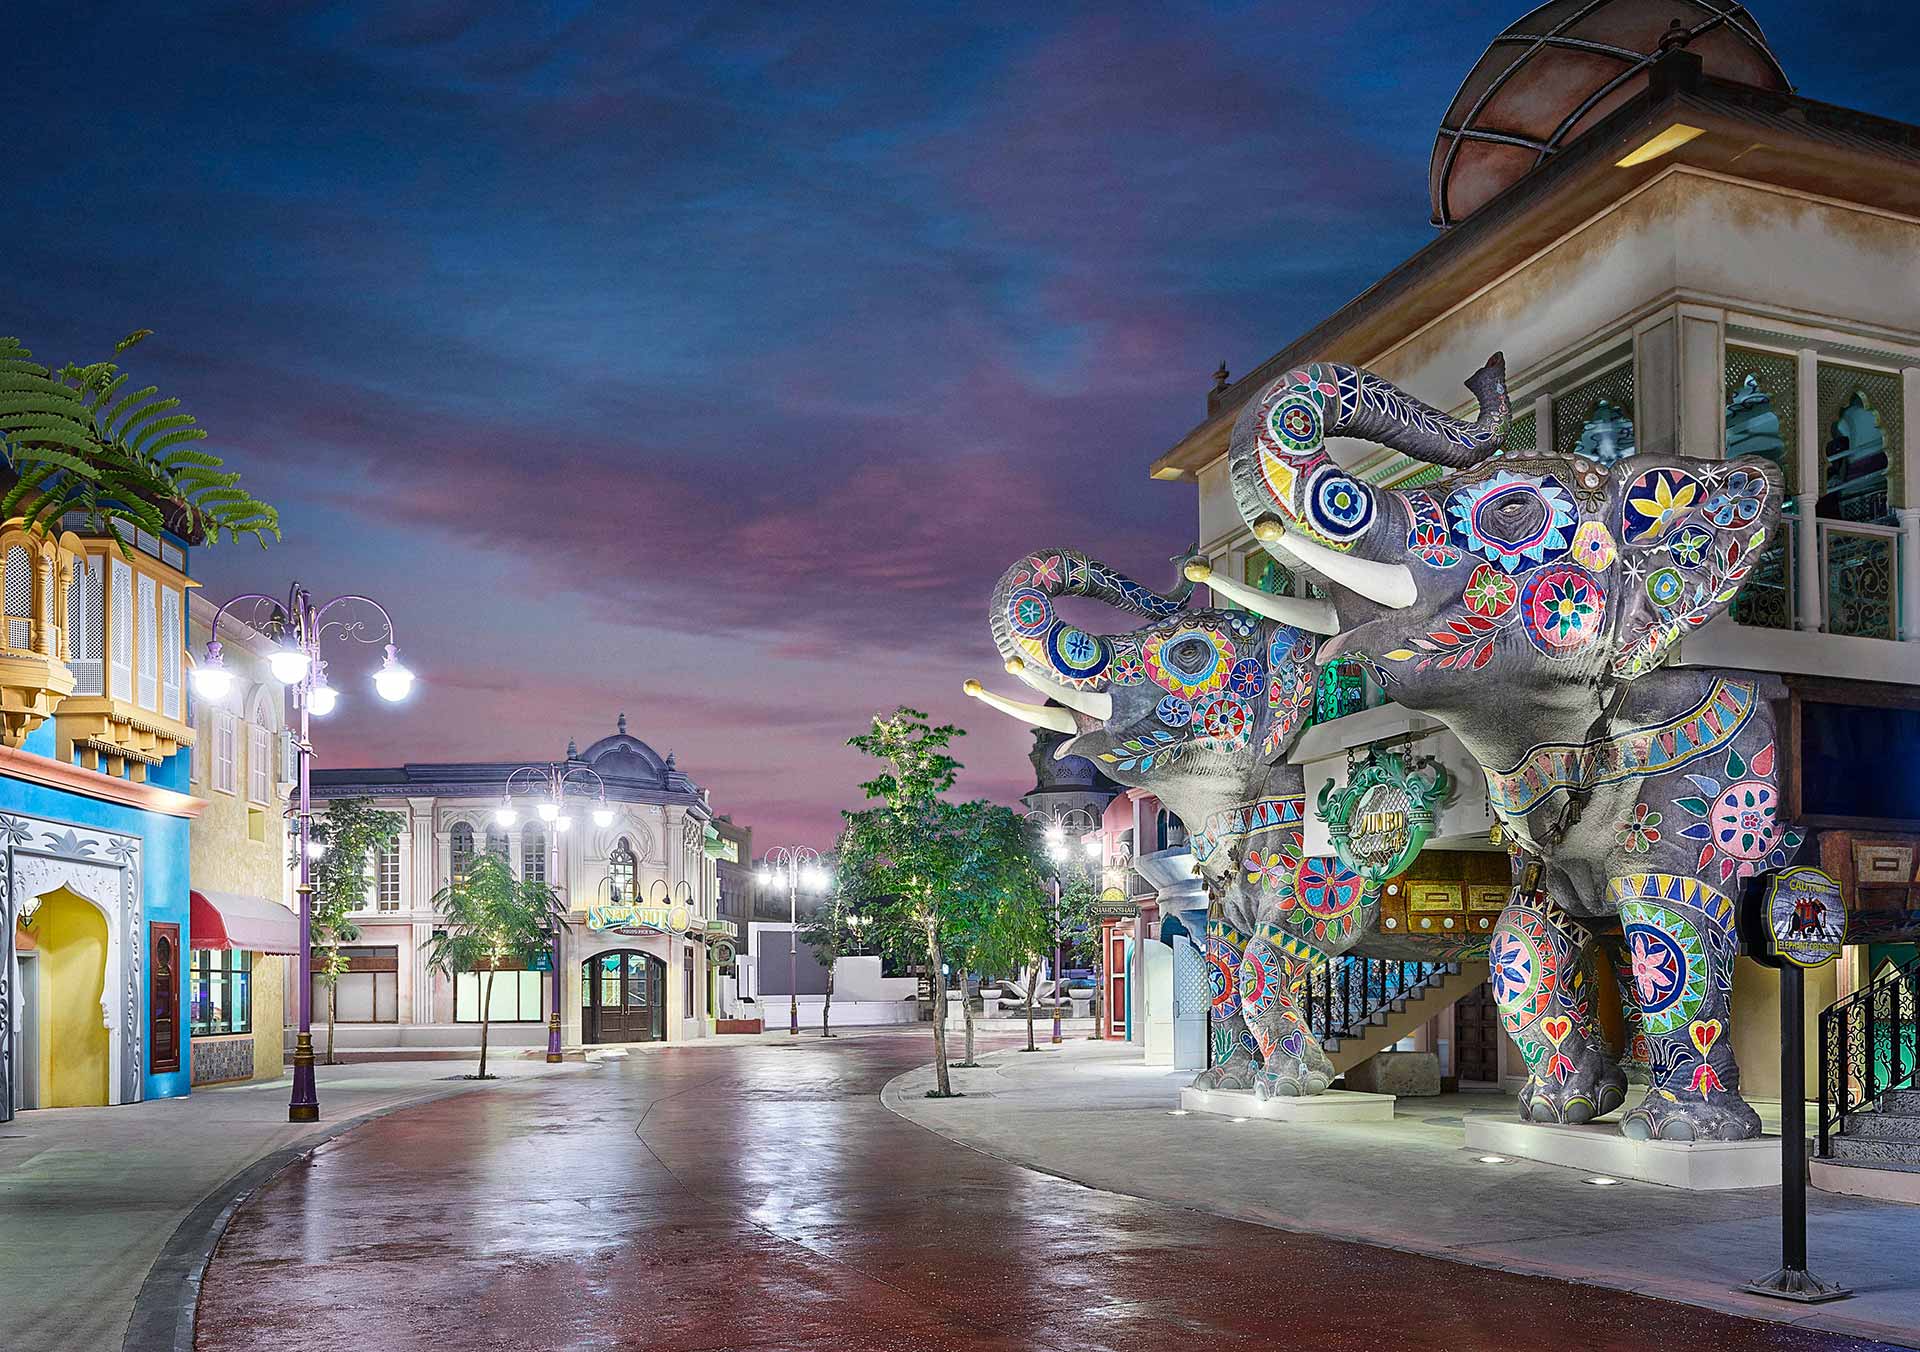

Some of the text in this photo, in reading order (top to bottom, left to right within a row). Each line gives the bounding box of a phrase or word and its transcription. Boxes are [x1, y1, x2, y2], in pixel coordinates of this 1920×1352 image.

[1349, 810, 1405, 840] JUMBO
[1789, 879, 1830, 893] CAUTION
[588, 905, 669, 930] SNAP SHOT
[1090, 906, 1136, 916] SHAHENSHAH
[1778, 940, 1808, 950] ELEPHANT
